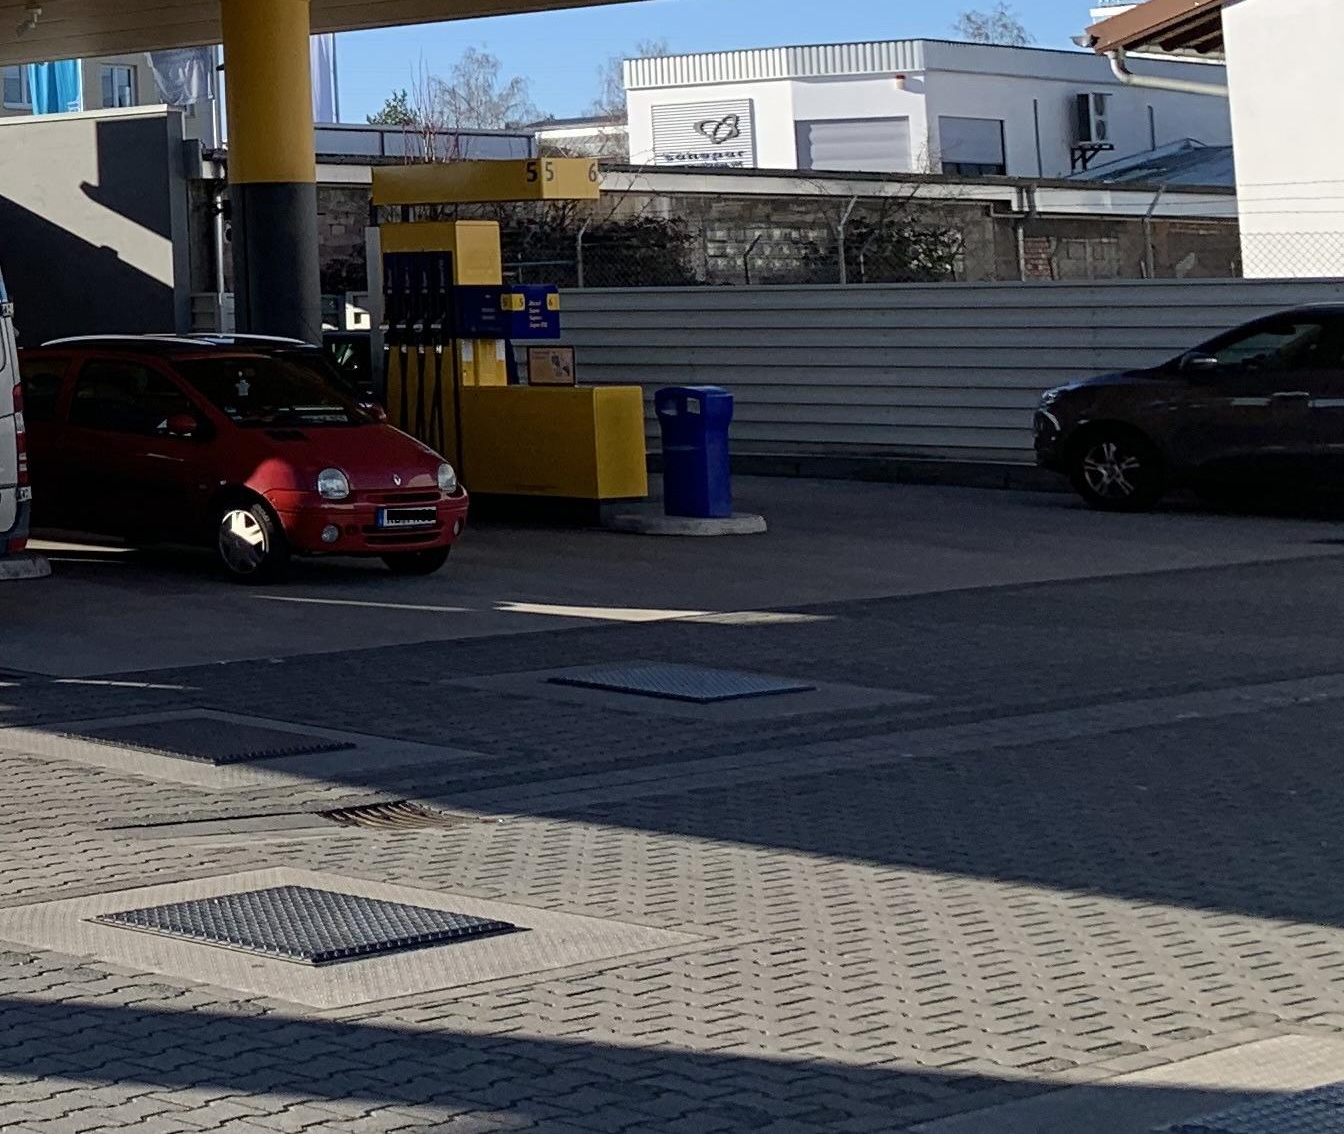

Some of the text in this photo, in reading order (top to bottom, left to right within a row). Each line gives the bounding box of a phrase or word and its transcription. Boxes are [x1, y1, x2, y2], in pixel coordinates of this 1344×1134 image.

[526, 161, 538, 183] 5
[545, 161, 597, 183] 5 6
